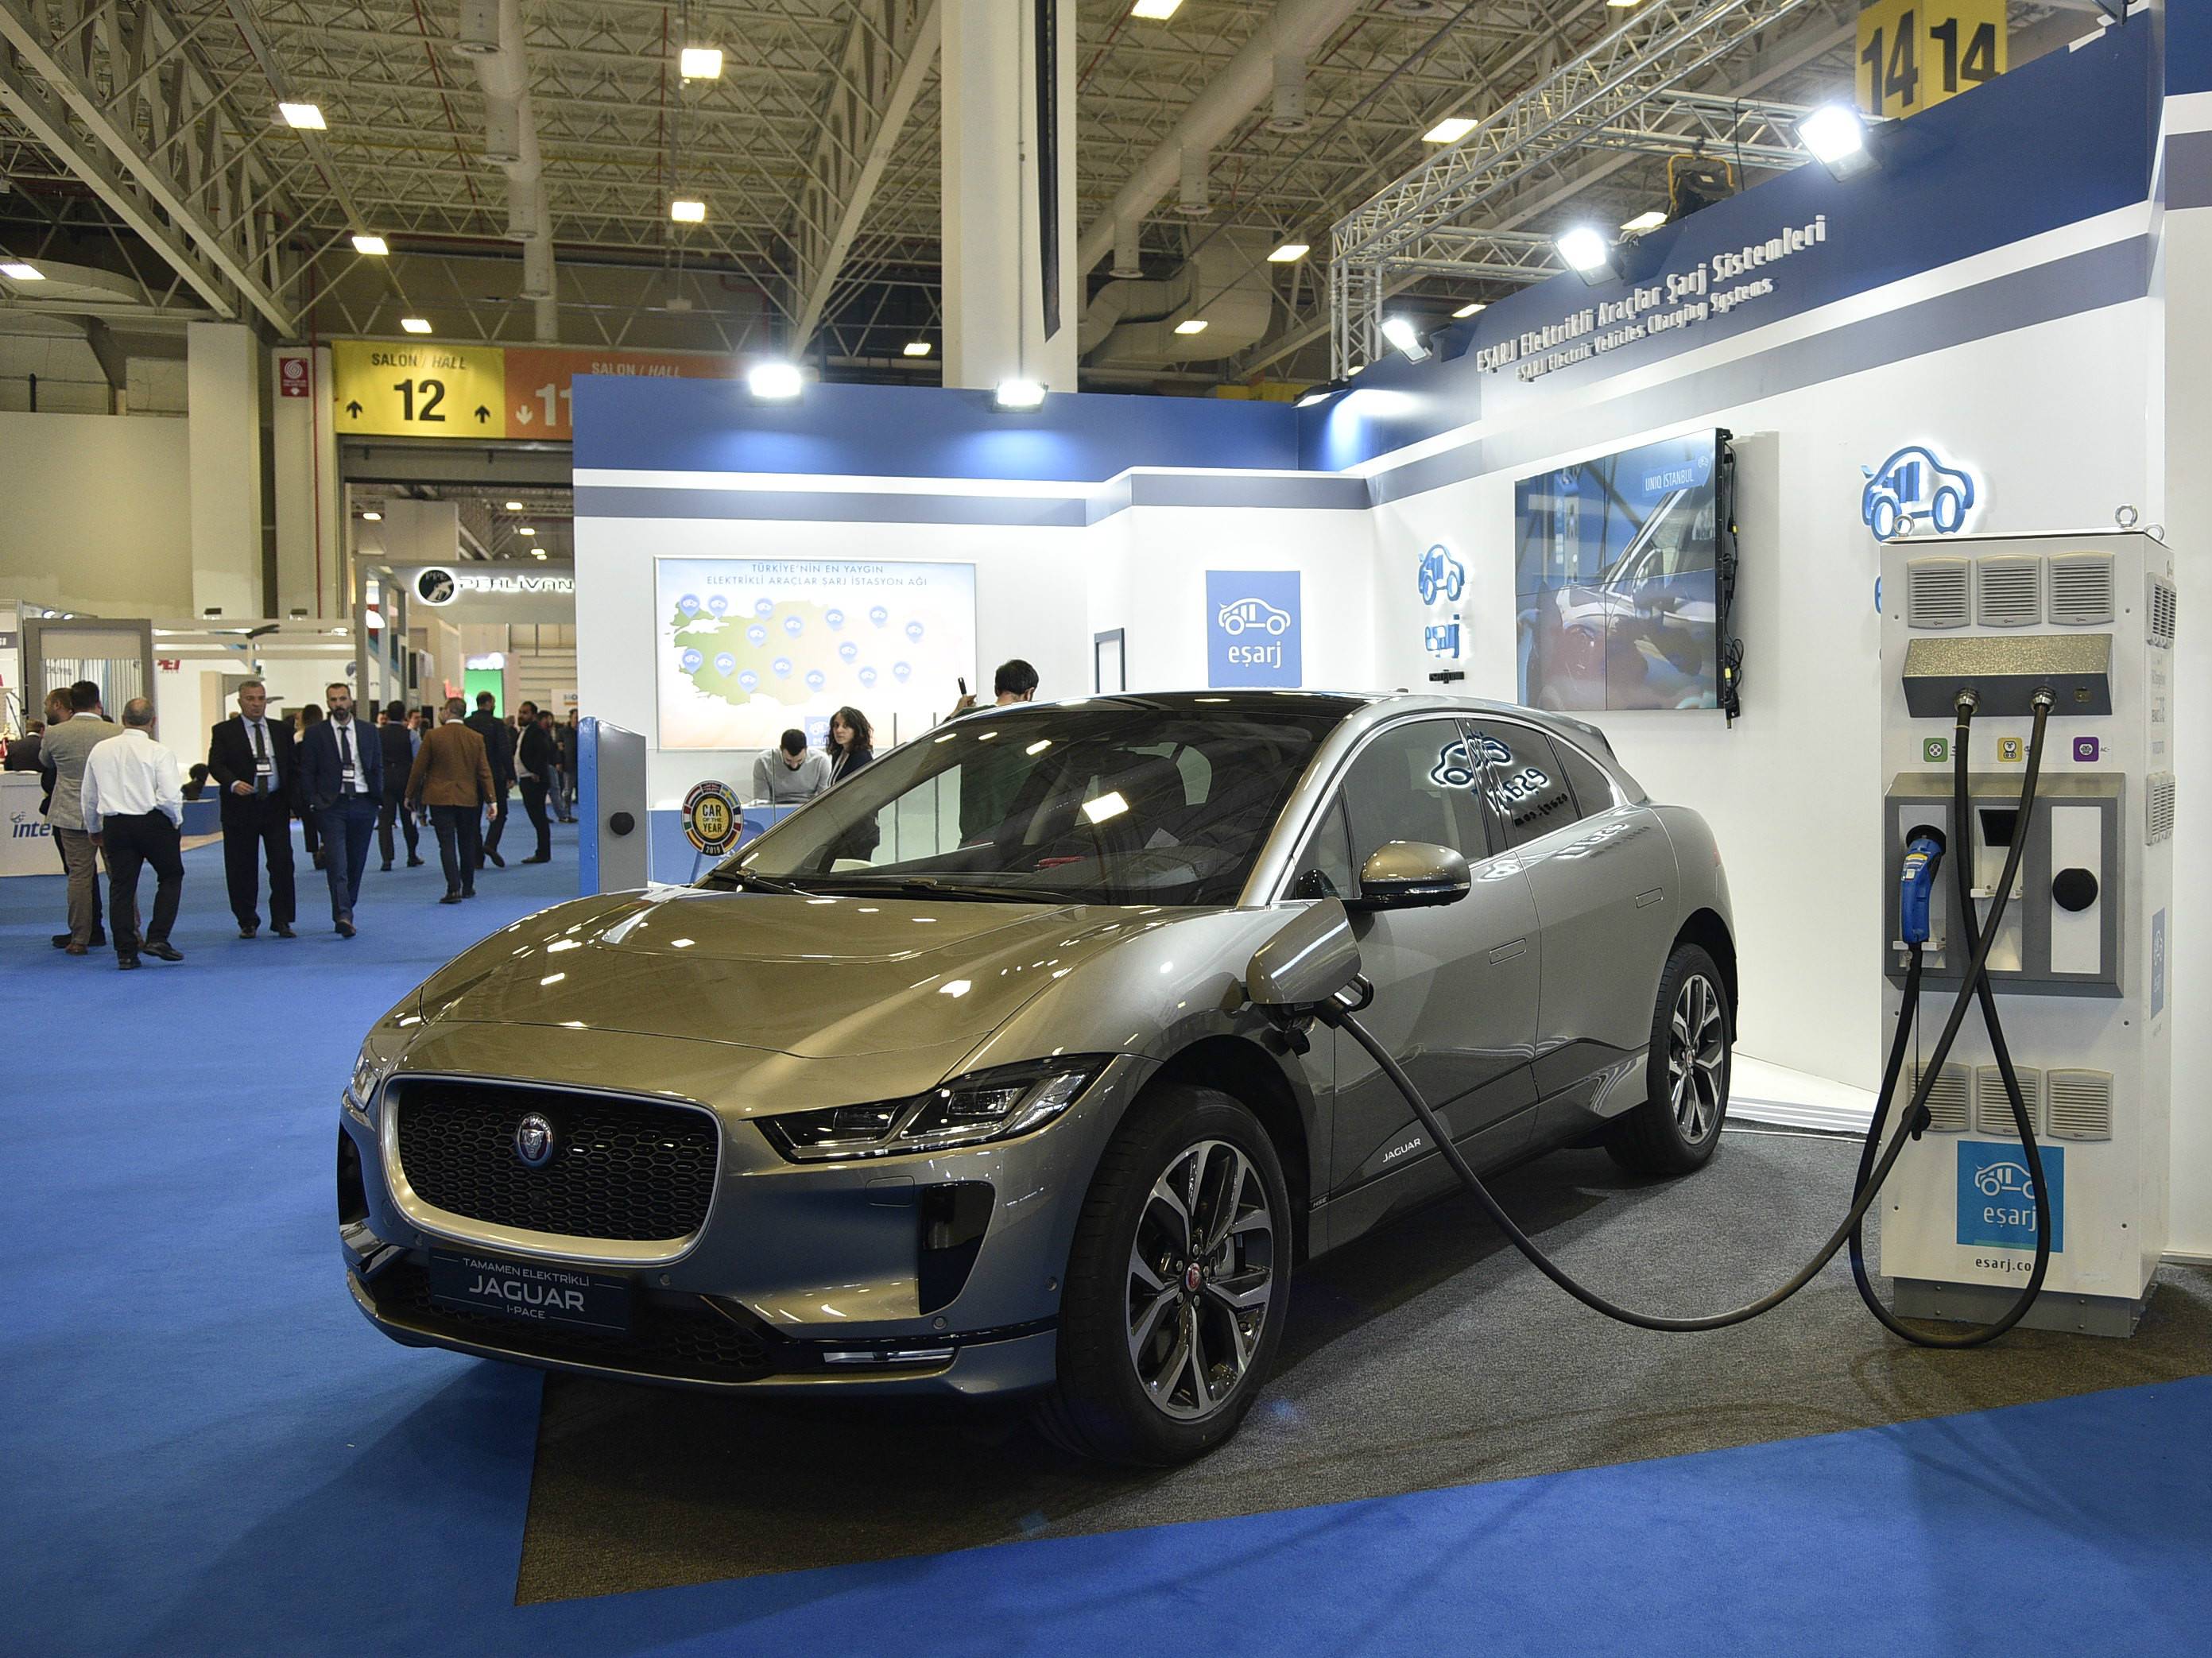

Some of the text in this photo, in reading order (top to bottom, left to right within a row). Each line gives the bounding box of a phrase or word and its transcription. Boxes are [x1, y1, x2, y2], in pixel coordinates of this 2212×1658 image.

[1861, 9, 1918, 115] 14
[1930, 17, 2001, 93] 14
[1521, 308, 1594, 356] Elektrikli
[1598, 286, 1663, 327] Araçlar
[1666, 263, 1707, 304] Şarj
[1712, 215, 1826, 282] Sistemleri
[1548, 343, 1592, 370] Electric
[1594, 325, 1646, 352] Vehicles
[1647, 302, 1708, 334] Charging
[1710, 278, 1774, 312] Systems
[371, 353, 418, 367] SALON
[432, 354, 467, 370] HALL
[591, 362, 636, 375] SALON
[648, 365, 681, 378] HALL
[393, 379, 446, 422] 12
[825, 564, 839, 573] EN
[843, 564, 884, 573] YAYGIN
[707, 575, 764, 585] ELEKTRİKLİ
[851, 575, 903, 586] İSTASYON
[703, 804, 722, 817] CAR
[13, 821, 52, 839] inte
[703, 823, 722, 833] YEAR
[1382, 1137, 1421, 1163] JAGUAR
[1313, 1196, 1327, 1207] HSE
[463, 1257, 590, 1287] TAMAMEN ELEKTRİKLİ
[1975, 1258, 2035, 1273] esarj.co
[468, 1275, 585, 1311] JAGUAR
[506, 1304, 546, 1319] I-PACE
